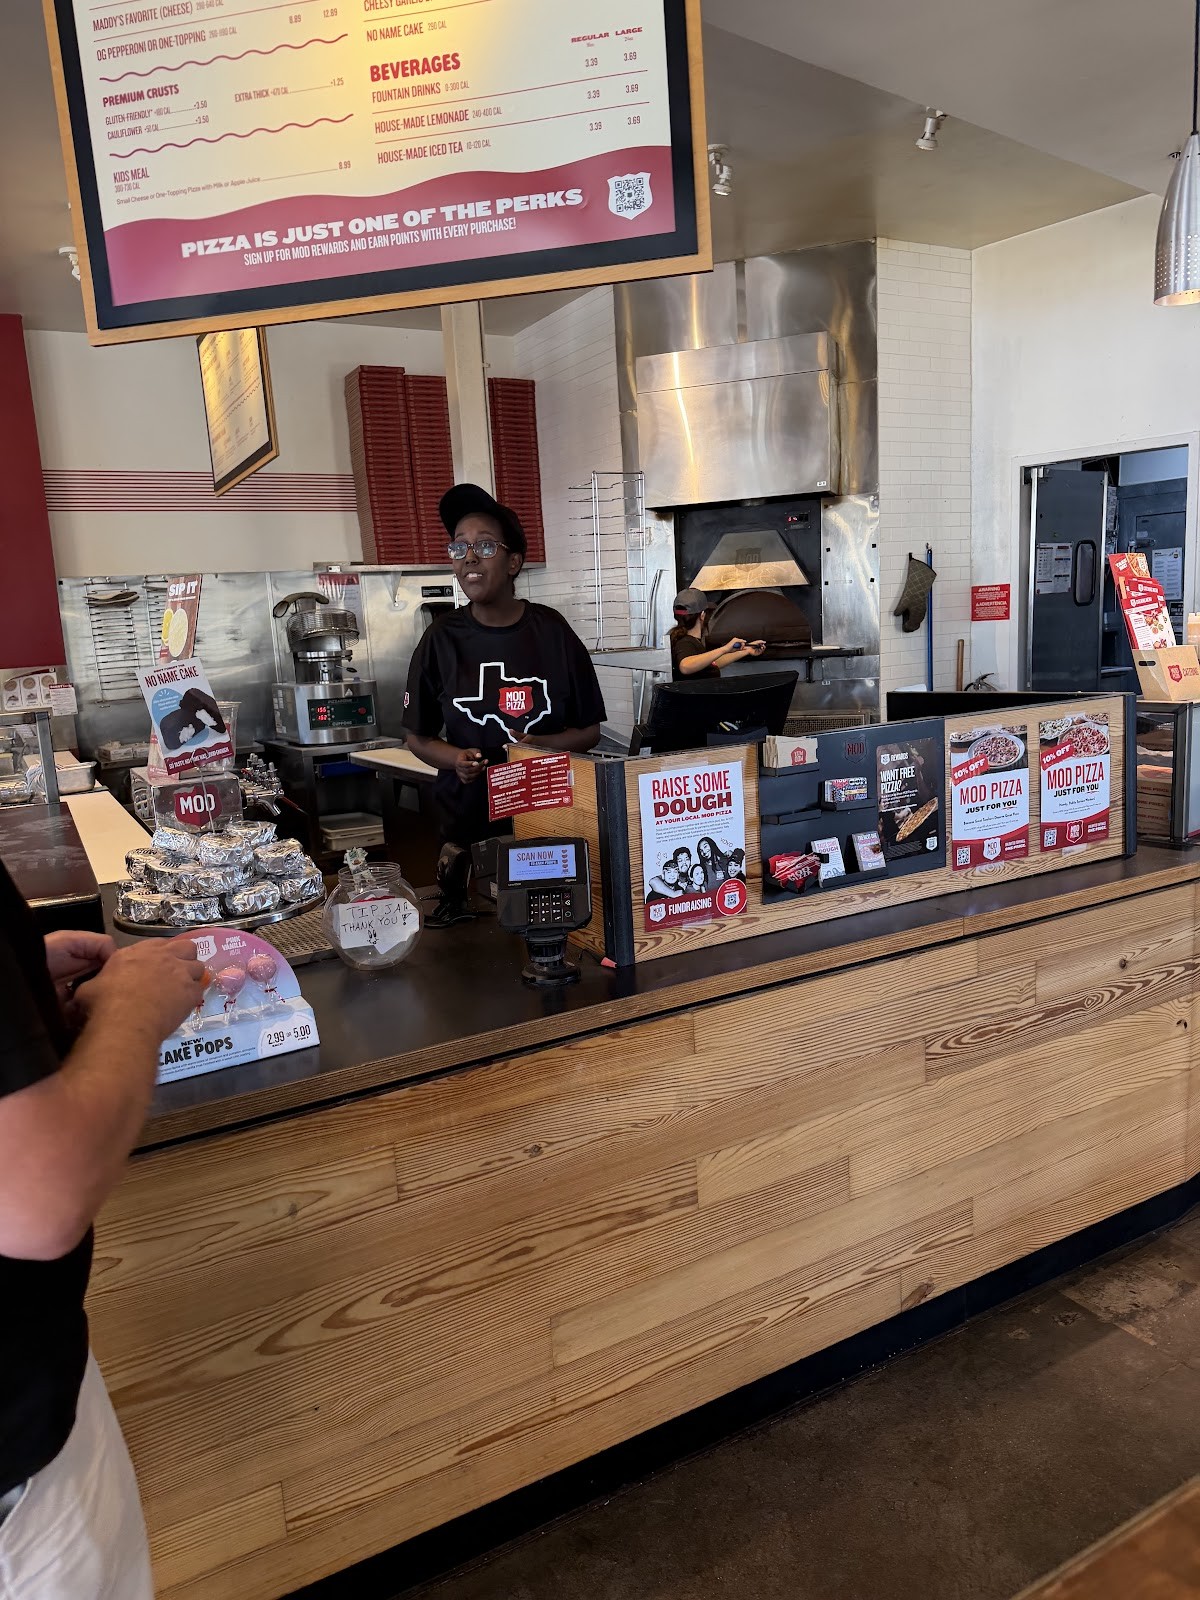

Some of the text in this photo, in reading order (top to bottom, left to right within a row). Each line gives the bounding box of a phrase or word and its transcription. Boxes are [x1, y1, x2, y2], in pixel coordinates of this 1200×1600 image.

[93, 14, 124, 31] MADDY'S
[125, 8, 158, 26] FAVORITE
[160, 1, 192, 20] (CHEESE)
[366, 30, 378, 42] NO
[380, 26, 402, 40] NAME
[404, 22, 424, 36] CAKE
[571, 26, 642, 43] REGULAR LARGE
[96, 48, 107, 61] OG
[108, 42, 146, 60] PEPPERONI
[147, 40, 158, 53] OR
[159, 30, 206, 50] ONE-TOPPING
[370, 52, 460, 82] BEVERAGES
[585, 52, 636, 68] 3.39 3.69
[102, 84, 179, 108] PREMIUM CRUSTS
[234, 90, 252, 102] EXTRA
[253, 88, 270, 100] THICK
[372, 86, 410, 104] FOUNTAIN
[412, 82, 441, 98] DRINKS
[460, 80, 470, 89] CAL
[587, 84, 638, 100] 3.39 3.69
[375, 116, 426, 134] HOUSE-MADE
[427, 109, 469, 126] LEMONADE
[493, 106, 502, 116] CAL
[590, 116, 640, 132] 3.39 3.69
[108, 126, 142, 140] CAULIFLOWER
[378, 145, 428, 164] HOUSE-MADE
[429, 144, 447, 156] ICED
[448, 141, 464, 154] TEA
[482, 139, 491, 148] CAL
[114, 167, 150, 184] KIDS MEAL
[117, 197, 130, 205] Small
[131, 194, 149, 203] Cheese
[156, 187, 187, 200] One-Topping
[188, 185, 201, 194] Pizza
[213, 182, 224, 190] Milk
[230, 178, 246, 188] Apple
[181, 188, 584, 258] PIZZA IS JUST ONE OF THE PERKS
[244, 217, 516, 266] SIGN UP FOR MOD REWARDS AND EARN POINTS WITH EVERY PURCHASE!
[168, 580, 198, 597] SIP IT
[145, 666, 199, 688] NO NAME CAKE
[506, 691, 526, 702] MOD
[506, 701, 526, 711] PIZZA
[1042, 744, 1070, 764] 10% OFF
[880, 766, 916, 782] WANT FREE
[954, 758, 985, 778] 10% OFF
[1048, 762, 1104, 790] MOD PIZZA
[652, 770, 730, 800] RAISE SOME
[881, 780, 902, 794] PIZZA?
[960, 778, 1022, 806] MOD PIZZA
[1054, 783, 1099, 798] JUST FOR YOU
[180, 794, 216, 814] MOD
[654, 792, 732, 818] DOUGH
[966, 800, 1018, 814] JUST FOR YOU
[516, 850, 554, 862] SCAN NOW
[346, 902, 408, 919] TIP JAR
[668, 898, 712, 916] FUNDRAISING
[342, 920, 374, 933] THANK
[181, 1038, 204, 1046] NEW!
[267, 1032, 284, 1044] 2.99
[294, 1025, 311, 1038] 5.00
[196, 1036, 234, 1057] POPS
